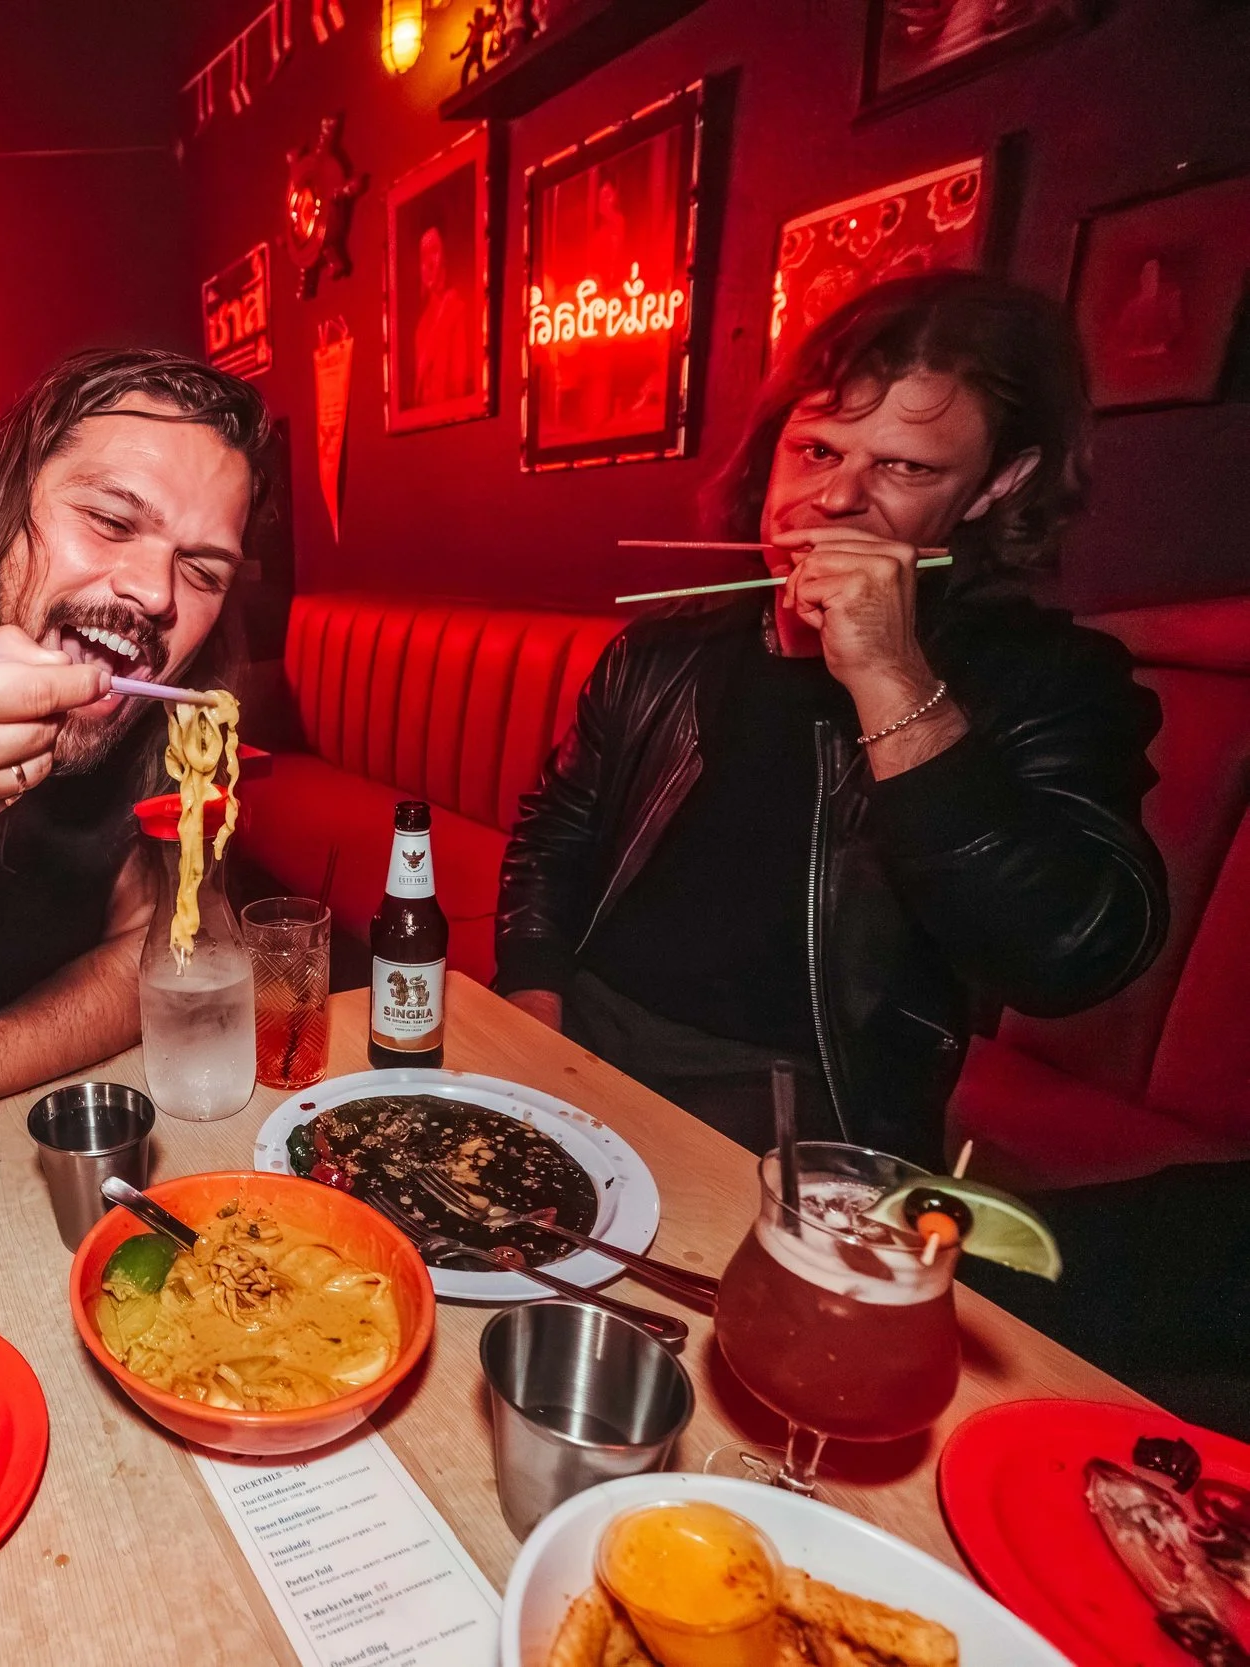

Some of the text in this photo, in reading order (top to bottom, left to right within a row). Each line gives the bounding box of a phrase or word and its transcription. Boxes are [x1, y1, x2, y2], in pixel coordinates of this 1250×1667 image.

[383, 1006, 433, 1019] SINGHA
[232, 1471, 283, 1495] COCKTAILS
[241, 1498, 257, 1509] Thai
[257, 1489, 274, 1502] Chili
[254, 1504, 321, 1535] Sweet Retribution
[268, 1538, 312, 1559] Trinidaddy
[285, 1564, 333, 1589] Perfect Fold
[303, 1612, 312, 1621] X
[311, 1603, 338, 1619] Marks
[337, 1598, 353, 1609] the
[353, 1589, 373, 1602] Spot
[366, 1641, 390, 1658] Sling
